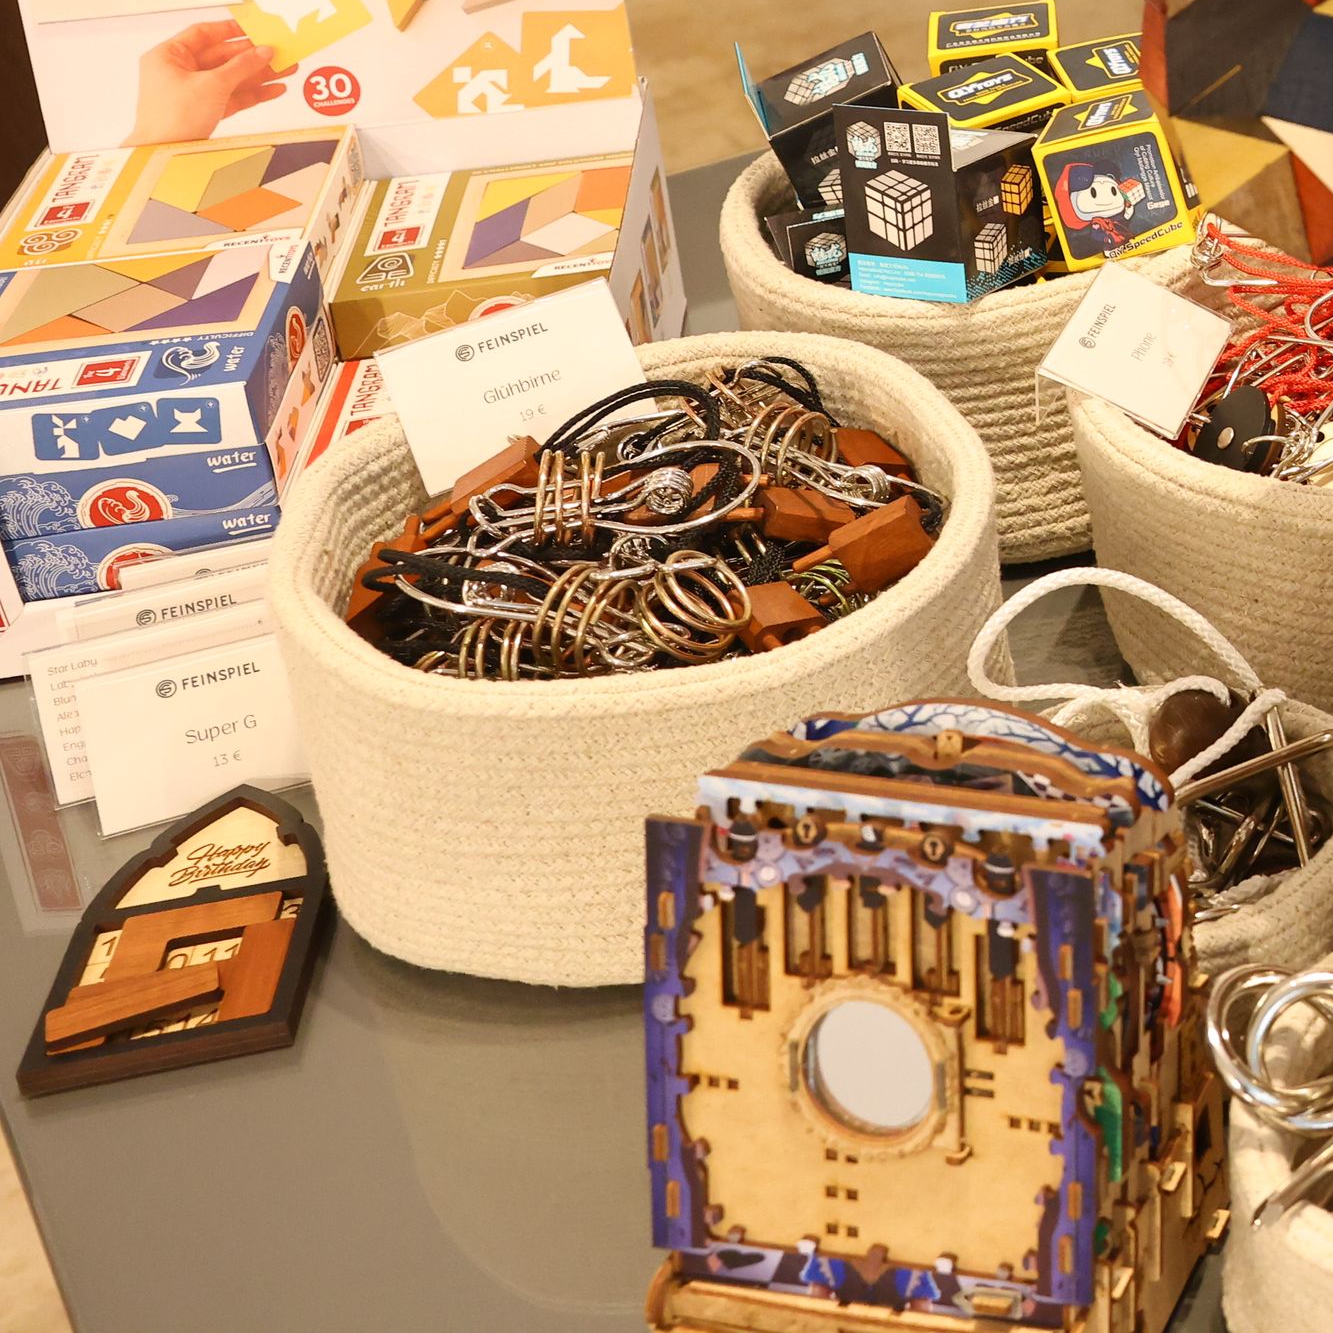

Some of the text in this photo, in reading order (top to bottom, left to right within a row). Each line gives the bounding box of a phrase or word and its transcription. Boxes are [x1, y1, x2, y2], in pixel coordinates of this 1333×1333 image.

[309, 72, 352, 101] 30
[52, 153, 100, 203] TANGRAM
[56, 207, 74, 218] 4
[384, 179, 420, 228] TANGRAM
[1147, 199, 1171, 211] Gege
[391, 231, 407, 243] 4
[1127, 221, 1183, 251] SpeedCube
[360, 278, 406, 293] earth
[1087, 303, 1117, 339] FEINSPIEL
[197, 331, 254, 343] DIFFICULTY
[477, 322, 549, 353] FEINSPIEL
[1131, 331, 1158, 362] Phone
[224, 345, 246, 372] water
[483, 368, 562, 404] Glühbirne
[519, 404, 548, 423] 19 €
[206, 449, 256, 467] water
[222, 512, 271, 530] water
[161, 593, 237, 620] FEINSPIEL
[47, 665, 68, 677] Star
[181, 661, 261, 691] FEINSPIEL
[184, 714, 258, 745] Super G
[212, 749, 242, 768] 13 €
[186, 841, 271, 865] Happy
[168, 856, 271, 887] Birthday
